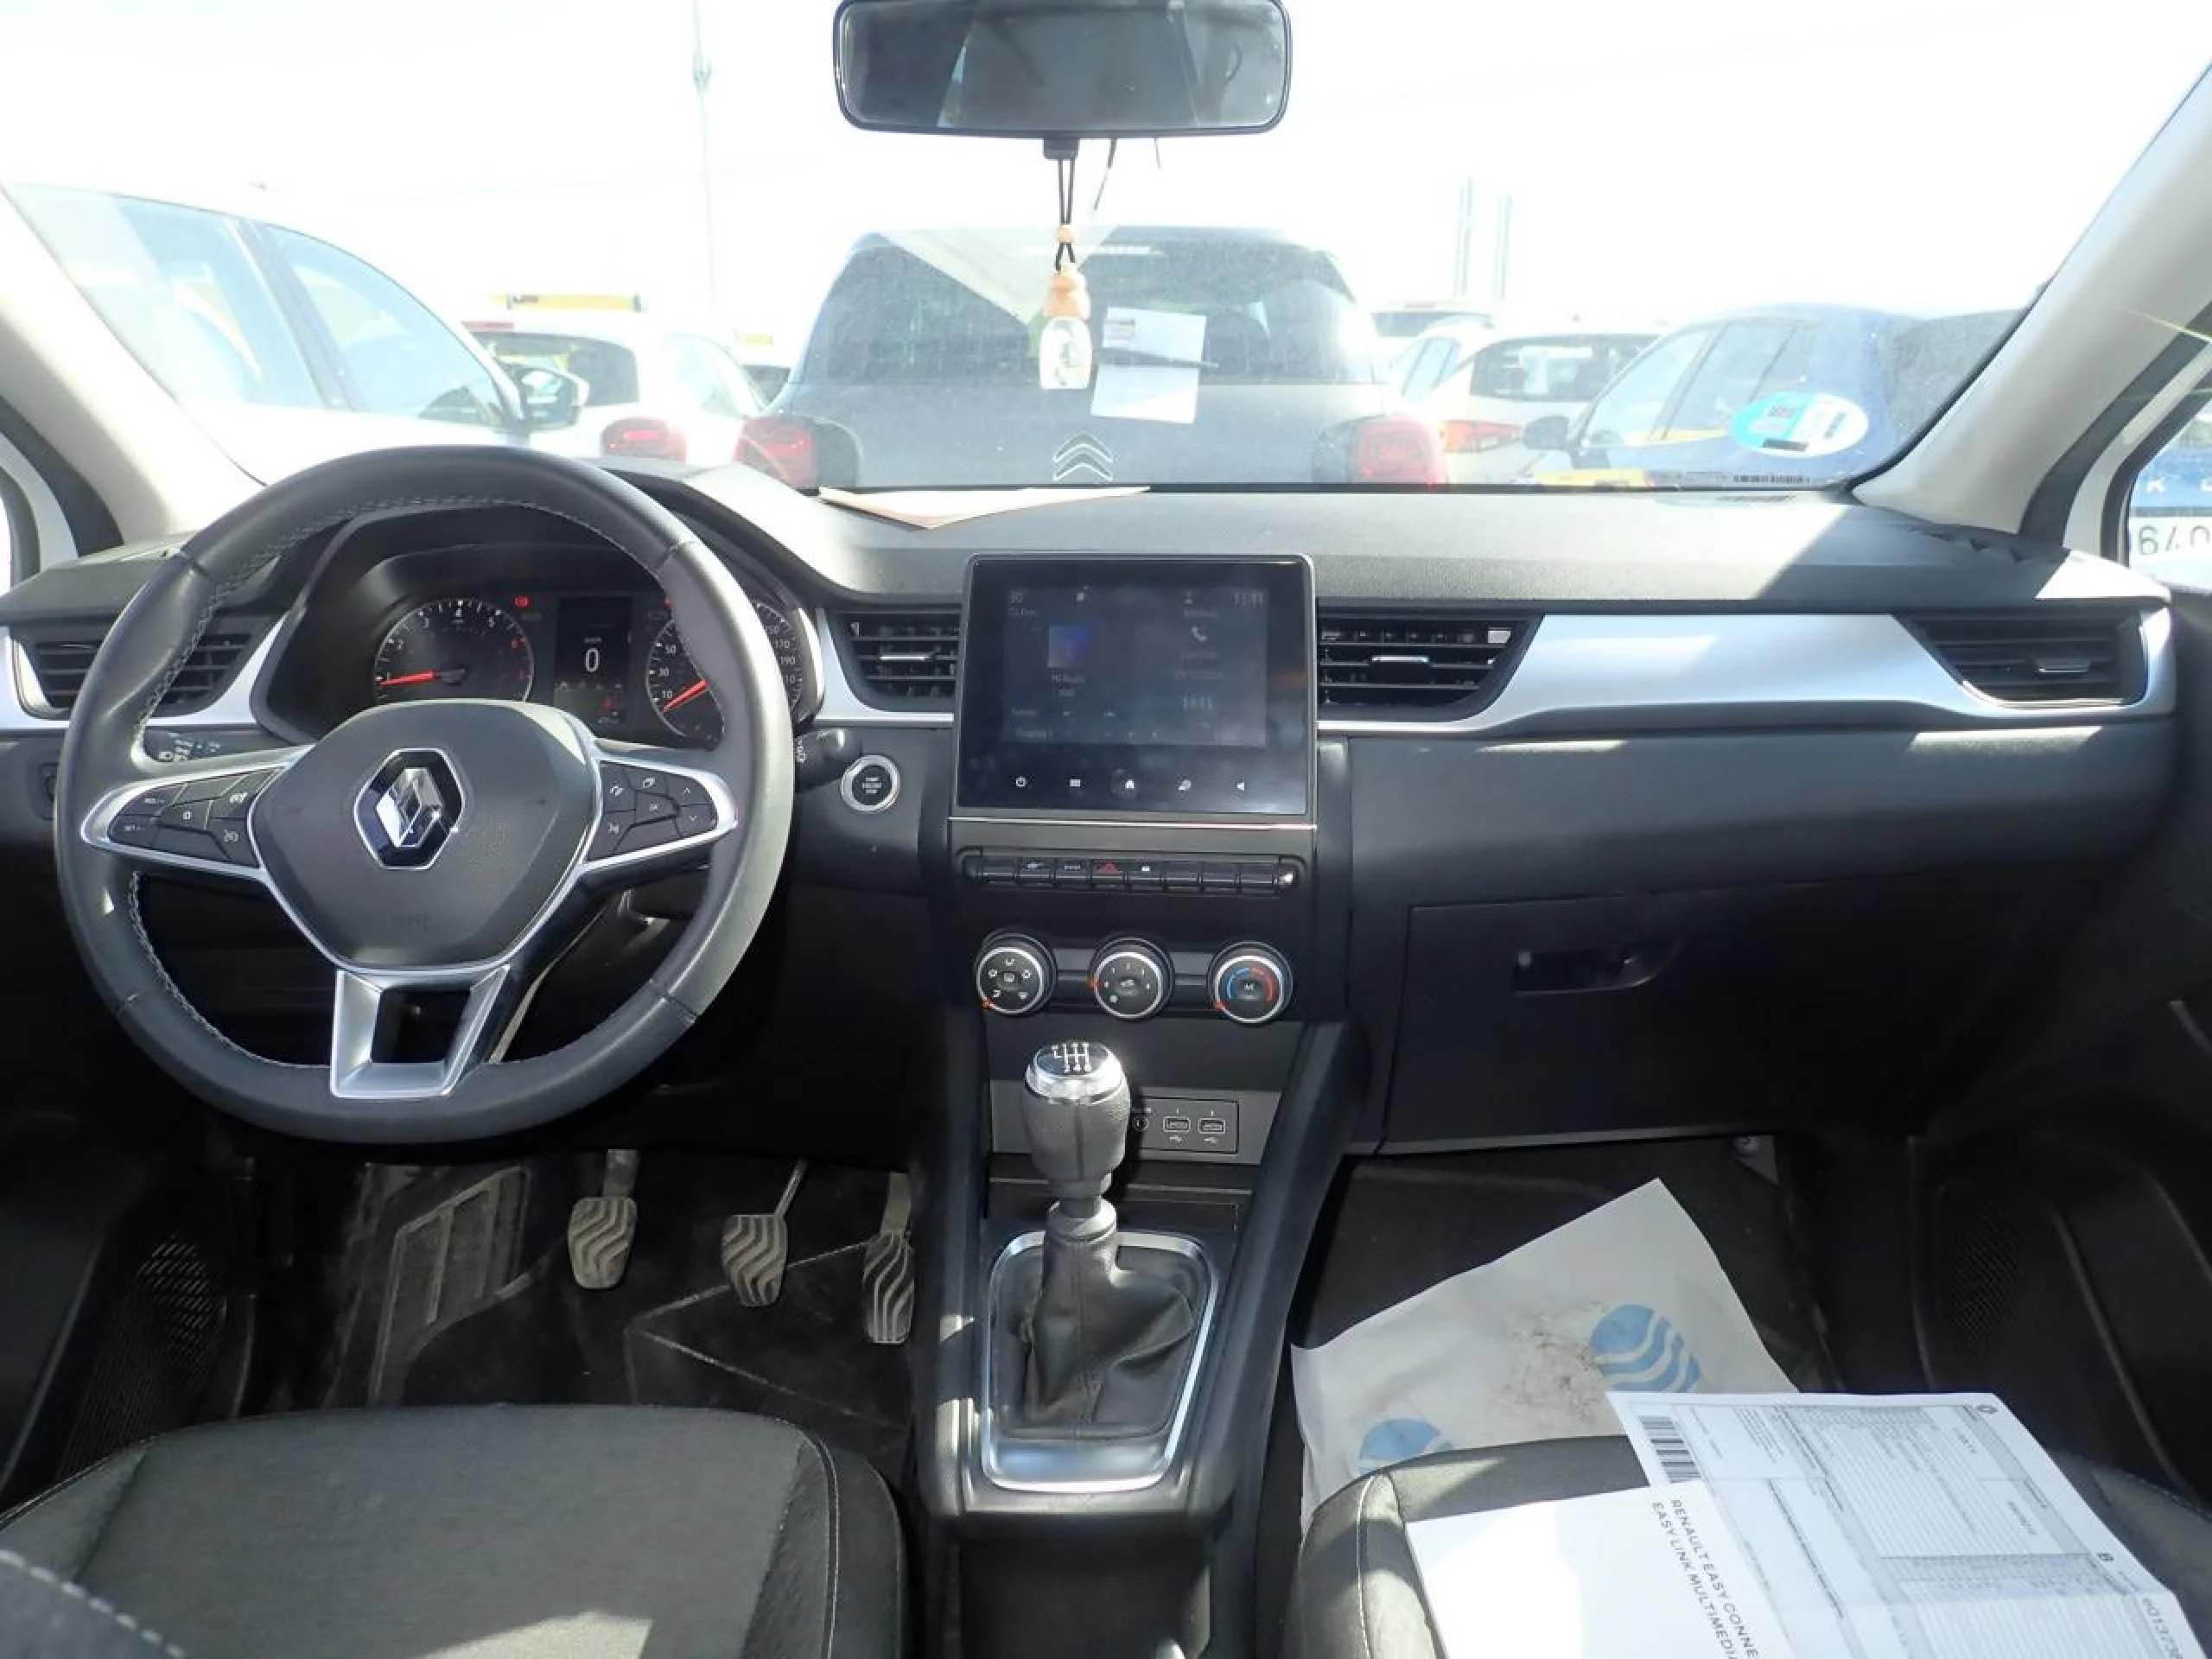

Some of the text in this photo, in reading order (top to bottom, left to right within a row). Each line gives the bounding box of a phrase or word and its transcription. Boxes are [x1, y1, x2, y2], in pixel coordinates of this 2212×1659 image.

[584, 647, 601, 673] 0
[1652, 1502, 1738, 1659] EASY LINK MULTIMEDI
[1703, 1563, 1729, 1599] EASY
[1723, 1603, 1758, 1657] CONNE
